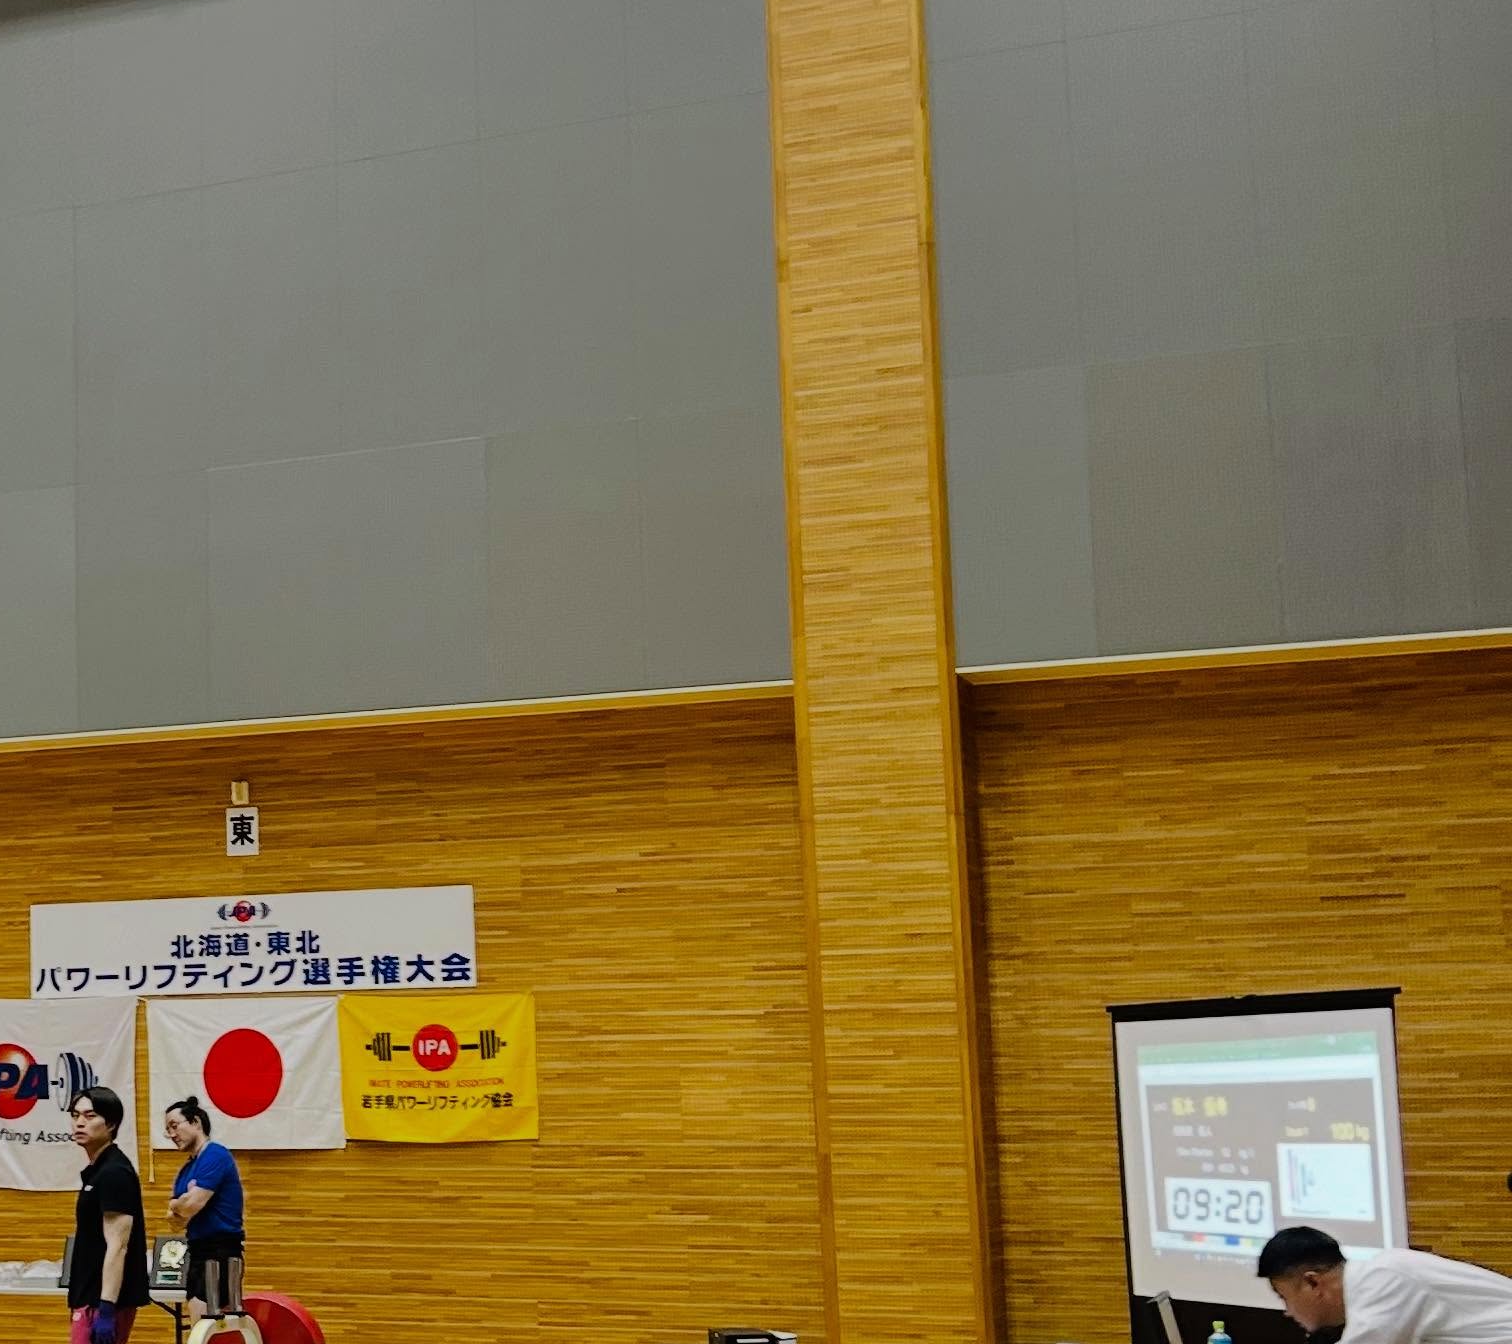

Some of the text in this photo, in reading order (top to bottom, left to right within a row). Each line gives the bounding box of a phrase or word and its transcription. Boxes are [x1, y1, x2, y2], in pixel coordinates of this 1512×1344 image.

[230, 814, 255, 845] 東
[170, 930, 321, 958] 北海道・東北
[36, 952, 472, 992] パワーリフティング選手権大会
[418, 1039, 452, 1056] IPA
[37, 1130, 75, 1143] Assoc
[1173, 1187, 1264, 1224] 09:20
